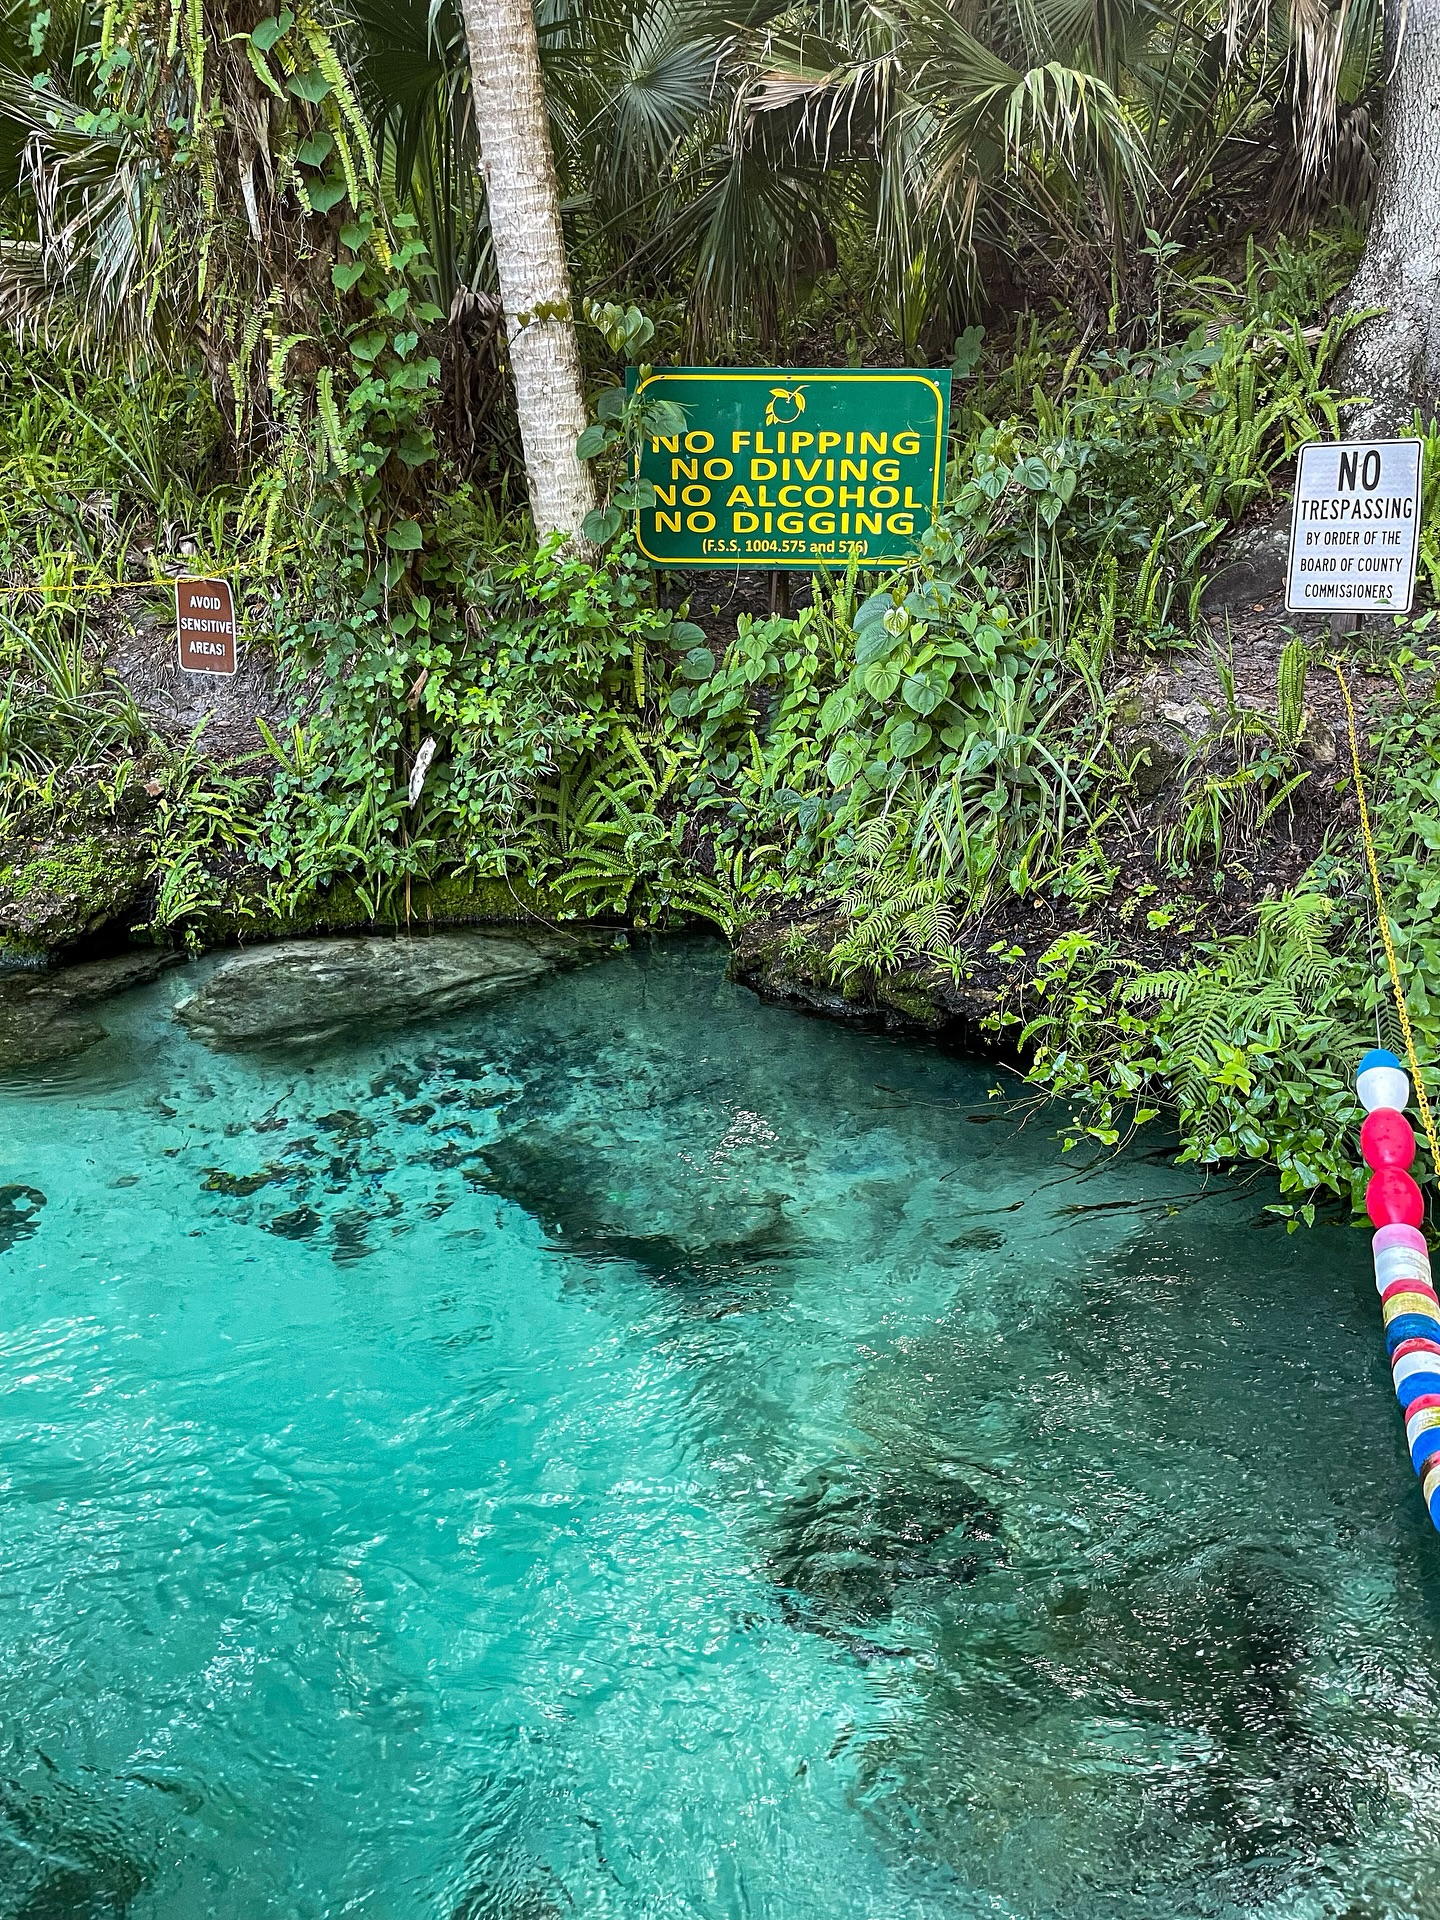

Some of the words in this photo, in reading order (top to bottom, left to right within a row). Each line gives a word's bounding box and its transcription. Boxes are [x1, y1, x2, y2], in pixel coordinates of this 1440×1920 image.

[652, 431, 715, 454] NO
[732, 431, 921, 455] FLIPPING
[671, 458, 734, 480] NO
[750, 459, 901, 482] DIVING
[1338, 450, 1381, 491] NO
[653, 485, 712, 507] NO
[726, 485, 922, 508] ALCOHOL
[1302, 498, 1412, 520] TRESPASSING
[655, 511, 716, 533] NO
[734, 512, 914, 535] DIGGING
[702, 538, 741, 553] (F.S.S.
[745, 540, 806, 553] 1004.575
[809, 540, 835, 553] and
[838, 540, 868, 554] 576)
[1306, 532, 1320, 545] BY
[1324, 532, 1359, 545] ORDER
[1364, 532, 1378, 545] OF
[1382, 531, 1401, 545] THE
[1301, 558, 1336, 571] BOARD
[1341, 558, 1354, 571] OF
[1358, 558, 1403, 571] COUNTY
[1305, 585, 1393, 598] COMMISSIONERS
[190, 596, 221, 610] AVOID
[181, 617, 232, 634] SENSITIVE
[189, 641, 225, 656] AREAS!
